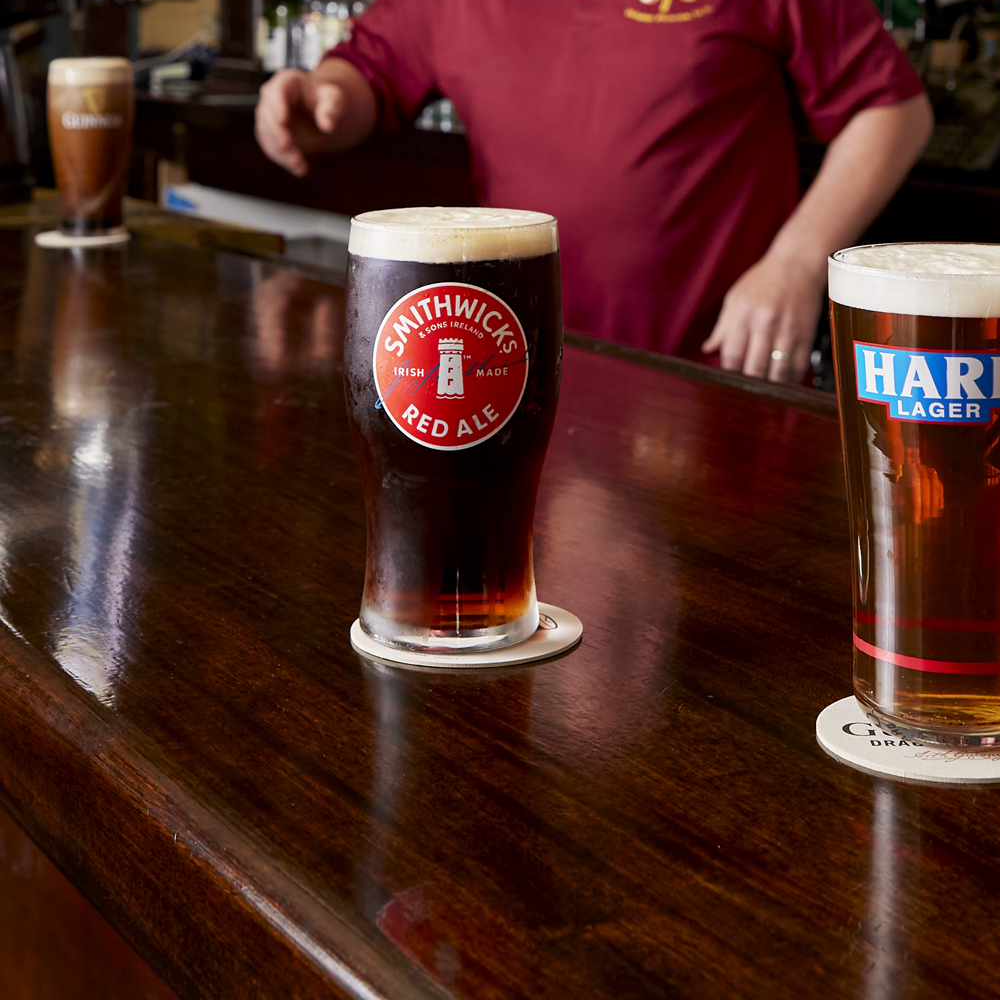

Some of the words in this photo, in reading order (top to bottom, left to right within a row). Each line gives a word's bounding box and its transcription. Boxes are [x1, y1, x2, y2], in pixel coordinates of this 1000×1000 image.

[425, 321, 448, 333] SONS
[450, 321, 484, 339] IRELAND
[393, 366, 424, 377] IRISH
[476, 367, 508, 377] MADE
[897, 400, 981, 418] LAGER
[401, 403, 449, 438] RED
[456, 403, 499, 438] ALE
